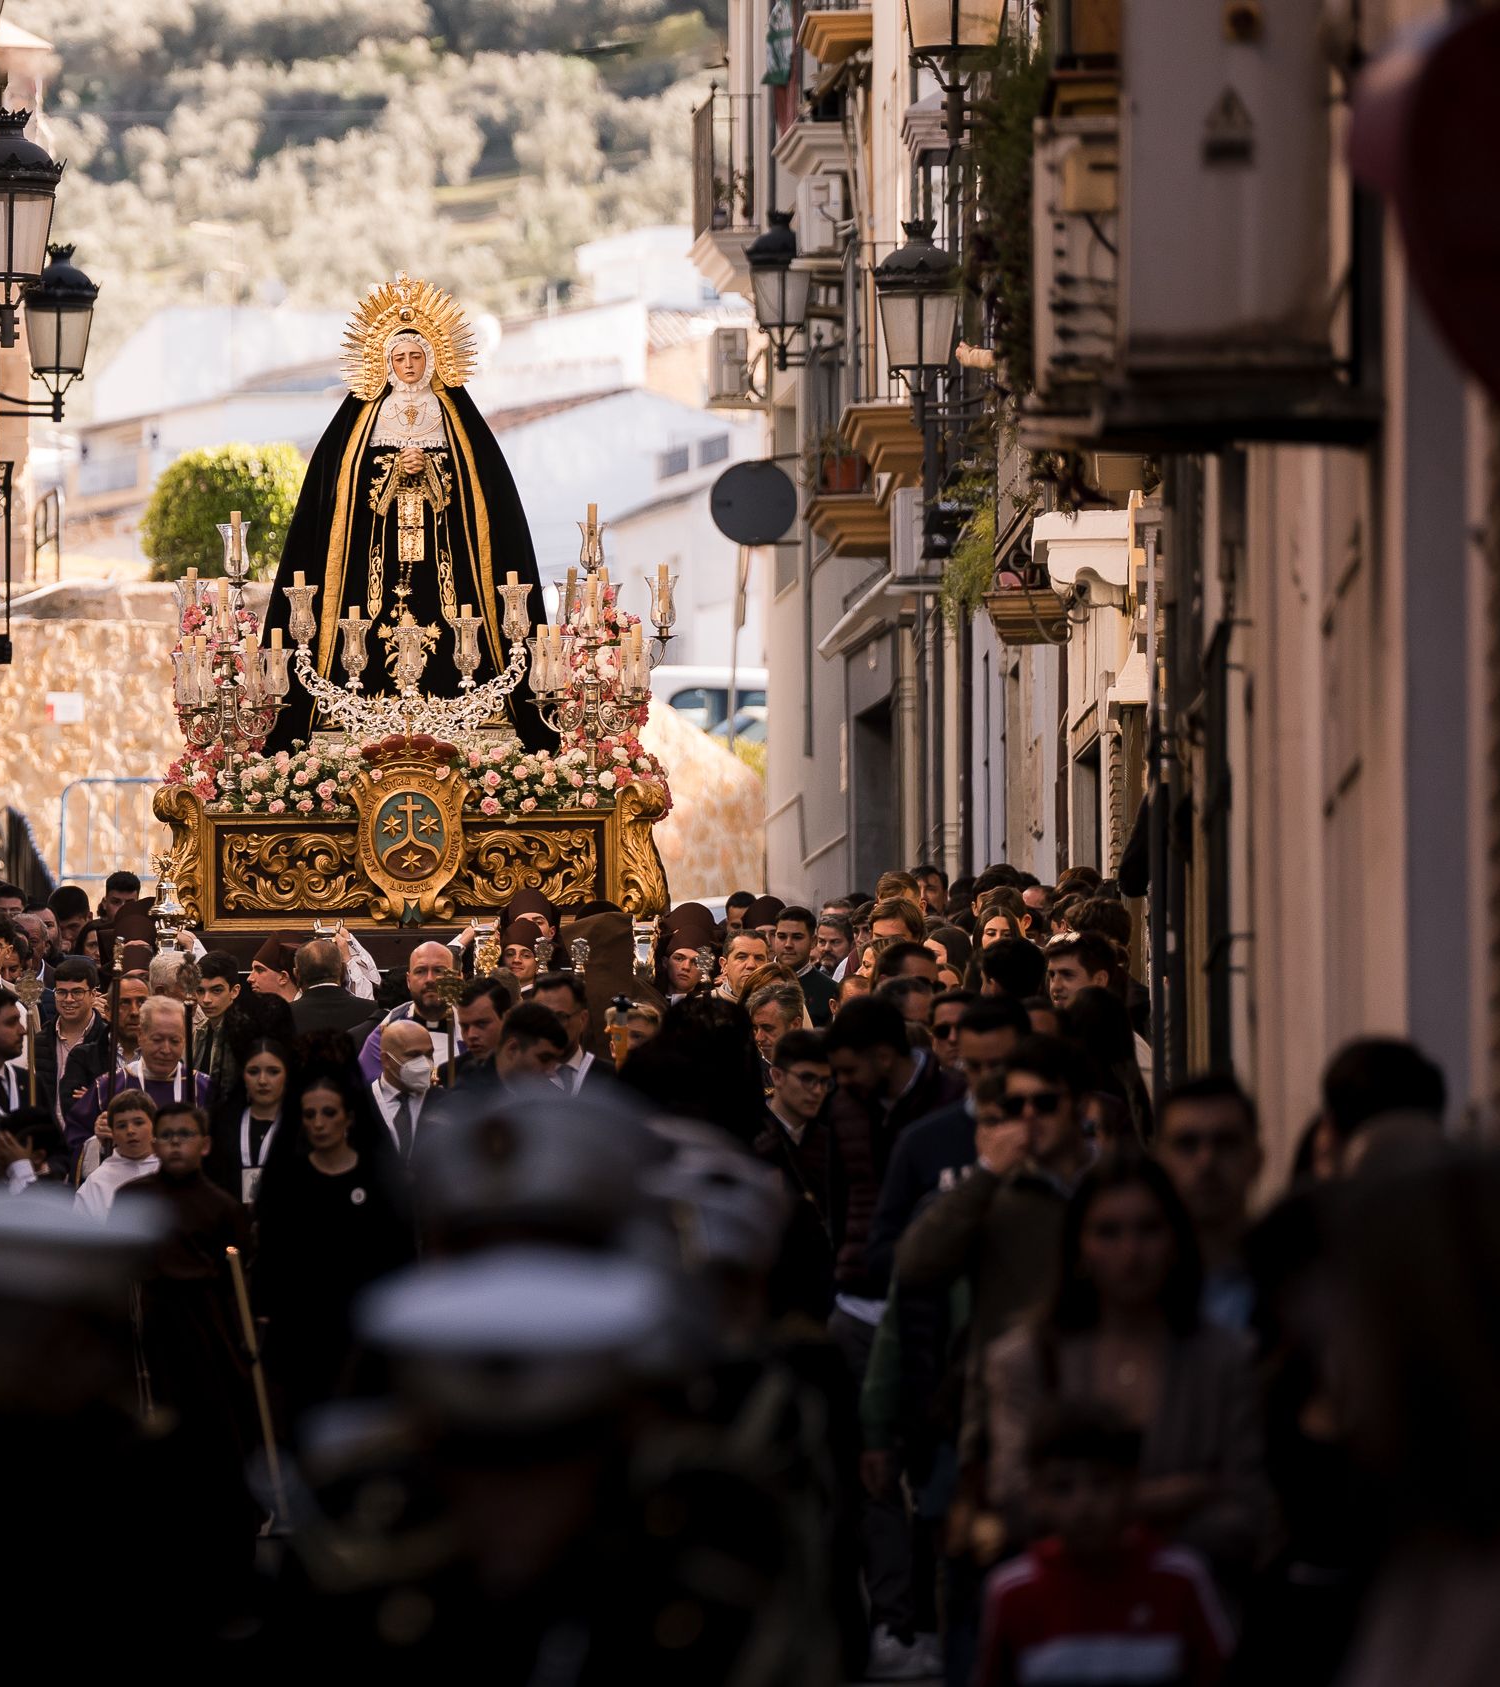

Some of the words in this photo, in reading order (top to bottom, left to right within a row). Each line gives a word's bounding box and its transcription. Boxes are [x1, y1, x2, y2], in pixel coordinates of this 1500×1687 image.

[381, 776, 412, 792] NTRA
[418, 777, 441, 796] SRA
[442, 797, 458, 822] DEL
[443, 830, 461, 873] CARMEN
[389, 879, 434, 894] LUCENA
